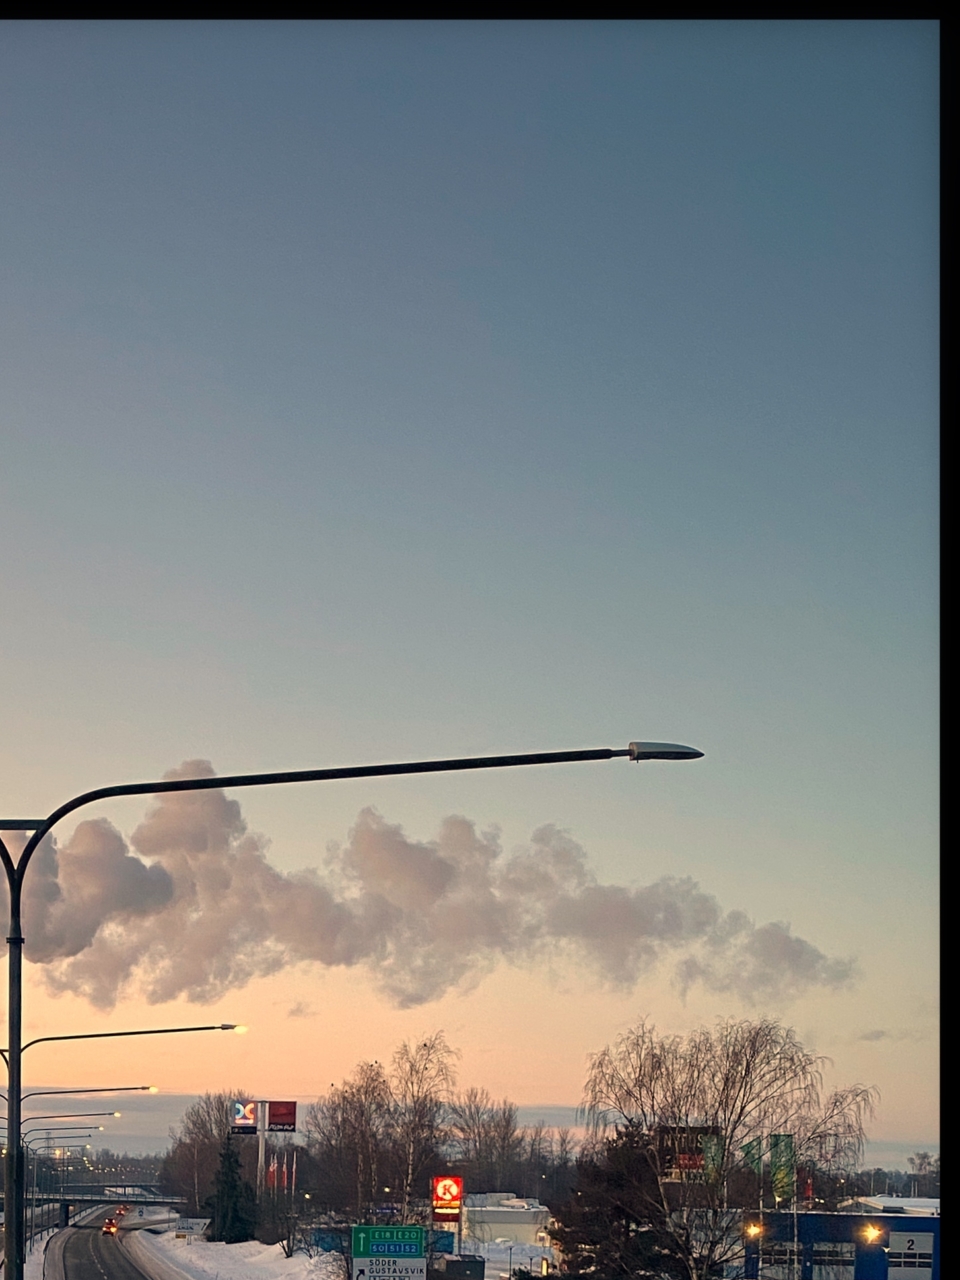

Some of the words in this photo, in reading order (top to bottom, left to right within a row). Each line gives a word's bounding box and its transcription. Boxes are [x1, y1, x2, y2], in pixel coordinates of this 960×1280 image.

[907, 1239, 915, 1251] 2
[369, 1258, 398, 1267] SÖDER
[368, 1267, 425, 1275] GUSTAVSVIK
